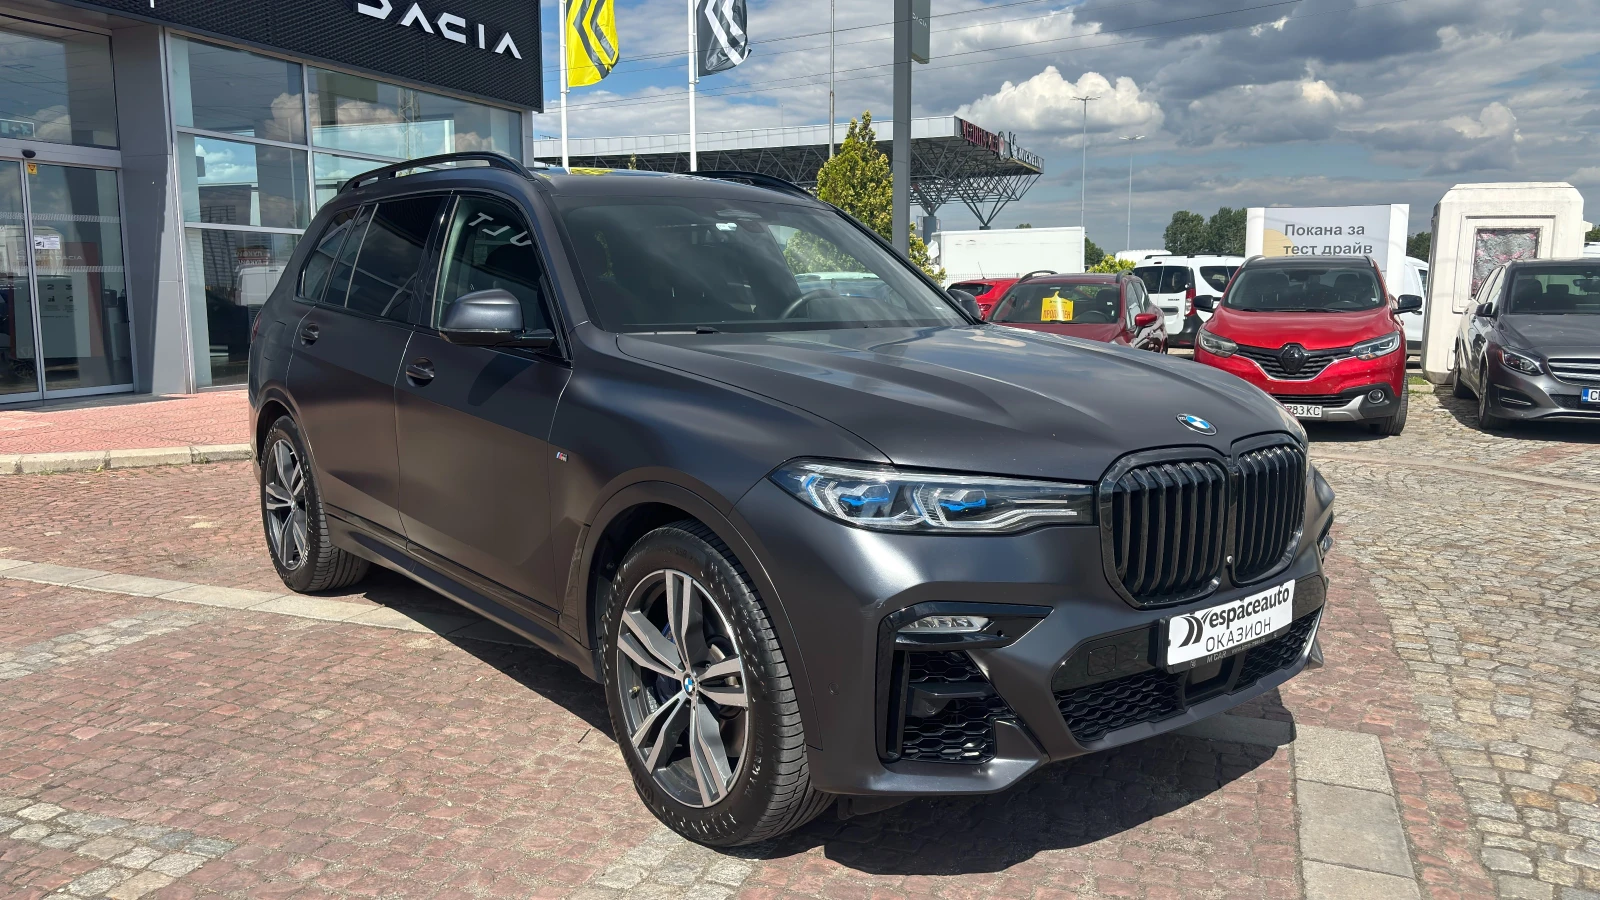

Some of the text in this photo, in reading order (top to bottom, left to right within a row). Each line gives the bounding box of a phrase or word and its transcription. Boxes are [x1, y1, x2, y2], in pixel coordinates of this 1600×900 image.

[1284, 223, 1365, 236] Покана за
[1283, 242, 1373, 256] тест драйв
[1208, 587, 1290, 630] espaceauto
[1205, 616, 1271, 653] ОКАЗИОН
